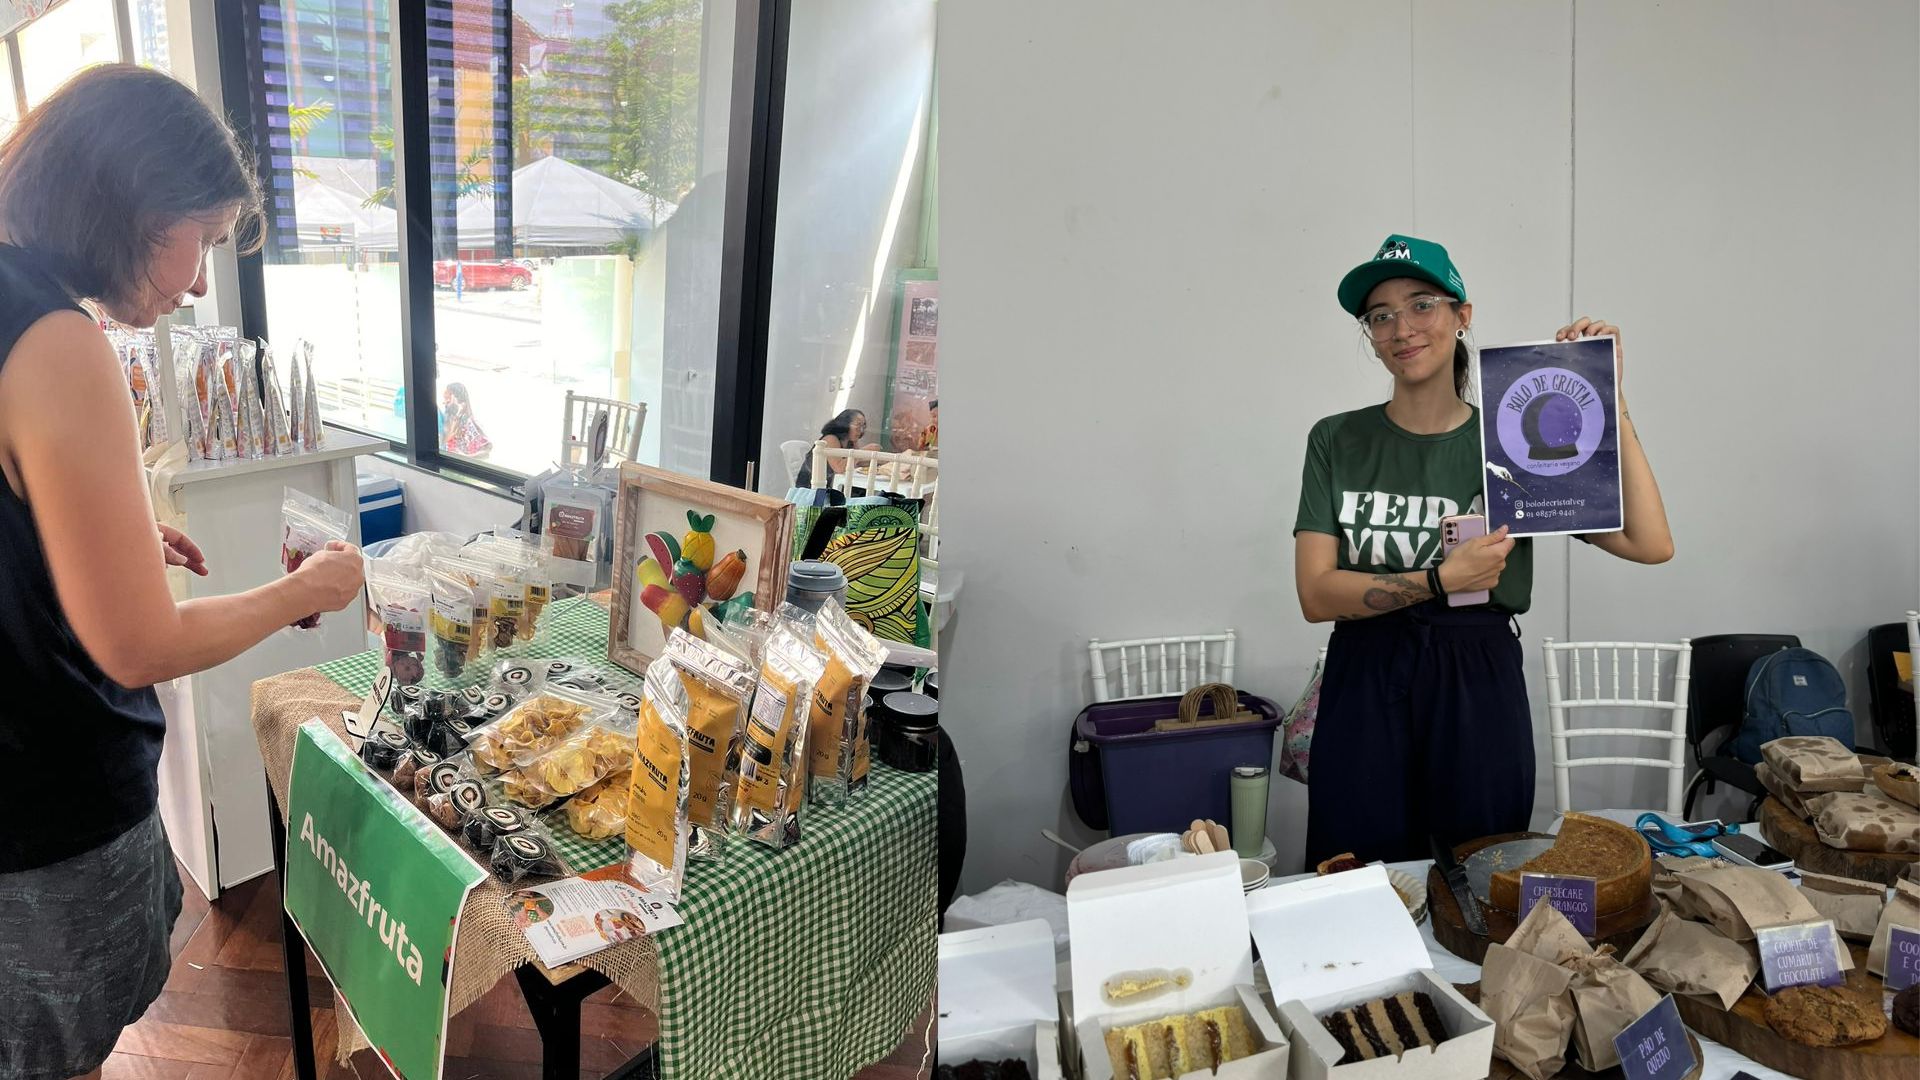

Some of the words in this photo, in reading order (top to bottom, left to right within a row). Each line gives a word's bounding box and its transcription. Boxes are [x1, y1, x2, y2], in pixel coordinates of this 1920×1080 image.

[1506, 384, 1533, 414] BOLO
[1532, 374, 1549, 393] DE
[1552, 374, 1595, 411] CRISTAL
[687, 725, 715, 748] ZFRUTA
[300, 812, 423, 987] Amazfruta
[1533, 885, 1584, 900] CHEESECAKE
[1550, 901, 1588, 913] ORANGOS
[1774, 939, 1804, 954] COOKIE
[1807, 937, 1819, 950] DE
[1899, 940, 1920, 956] COO
[1777, 953, 1812, 969] CUMARU
[1816, 952, 1823, 964] E
[1903, 956, 1910, 969] E
[1778, 966, 1827, 985] CHOCOLATE
[1654, 1026, 1667, 1046] DE
[1646, 1045, 1671, 1075] QUEIJO
